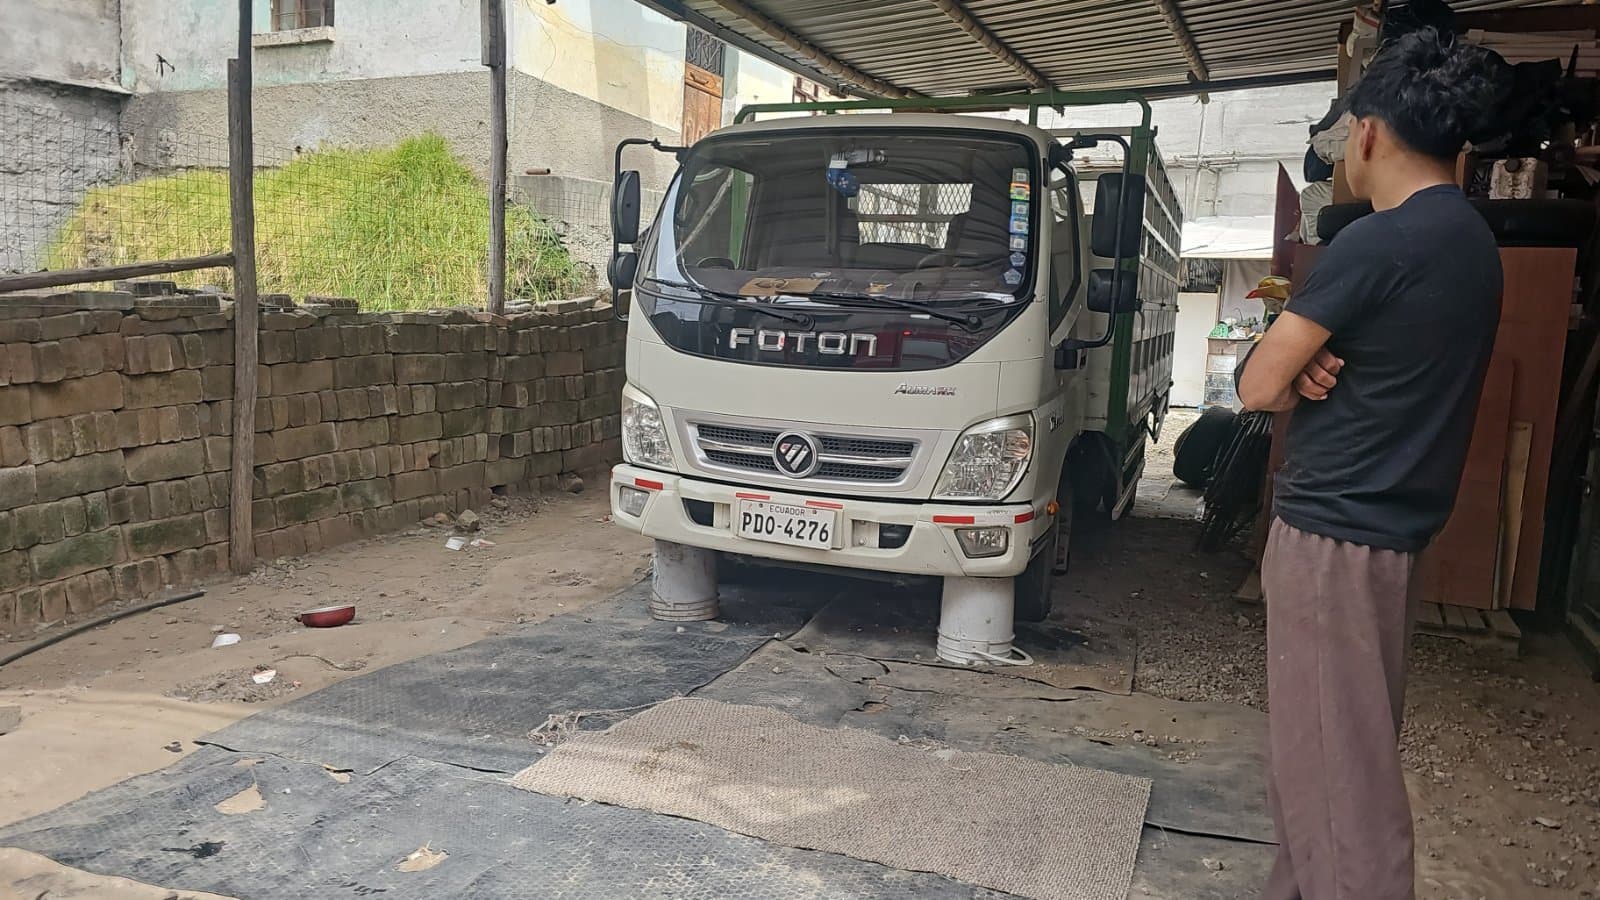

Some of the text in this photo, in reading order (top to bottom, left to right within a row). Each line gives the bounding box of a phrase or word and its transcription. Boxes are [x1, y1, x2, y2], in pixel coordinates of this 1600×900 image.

[730, 327, 877, 356] FOTON
[769, 505, 805, 515] ECUADOR
[742, 512, 829, 542] PDO-4276
